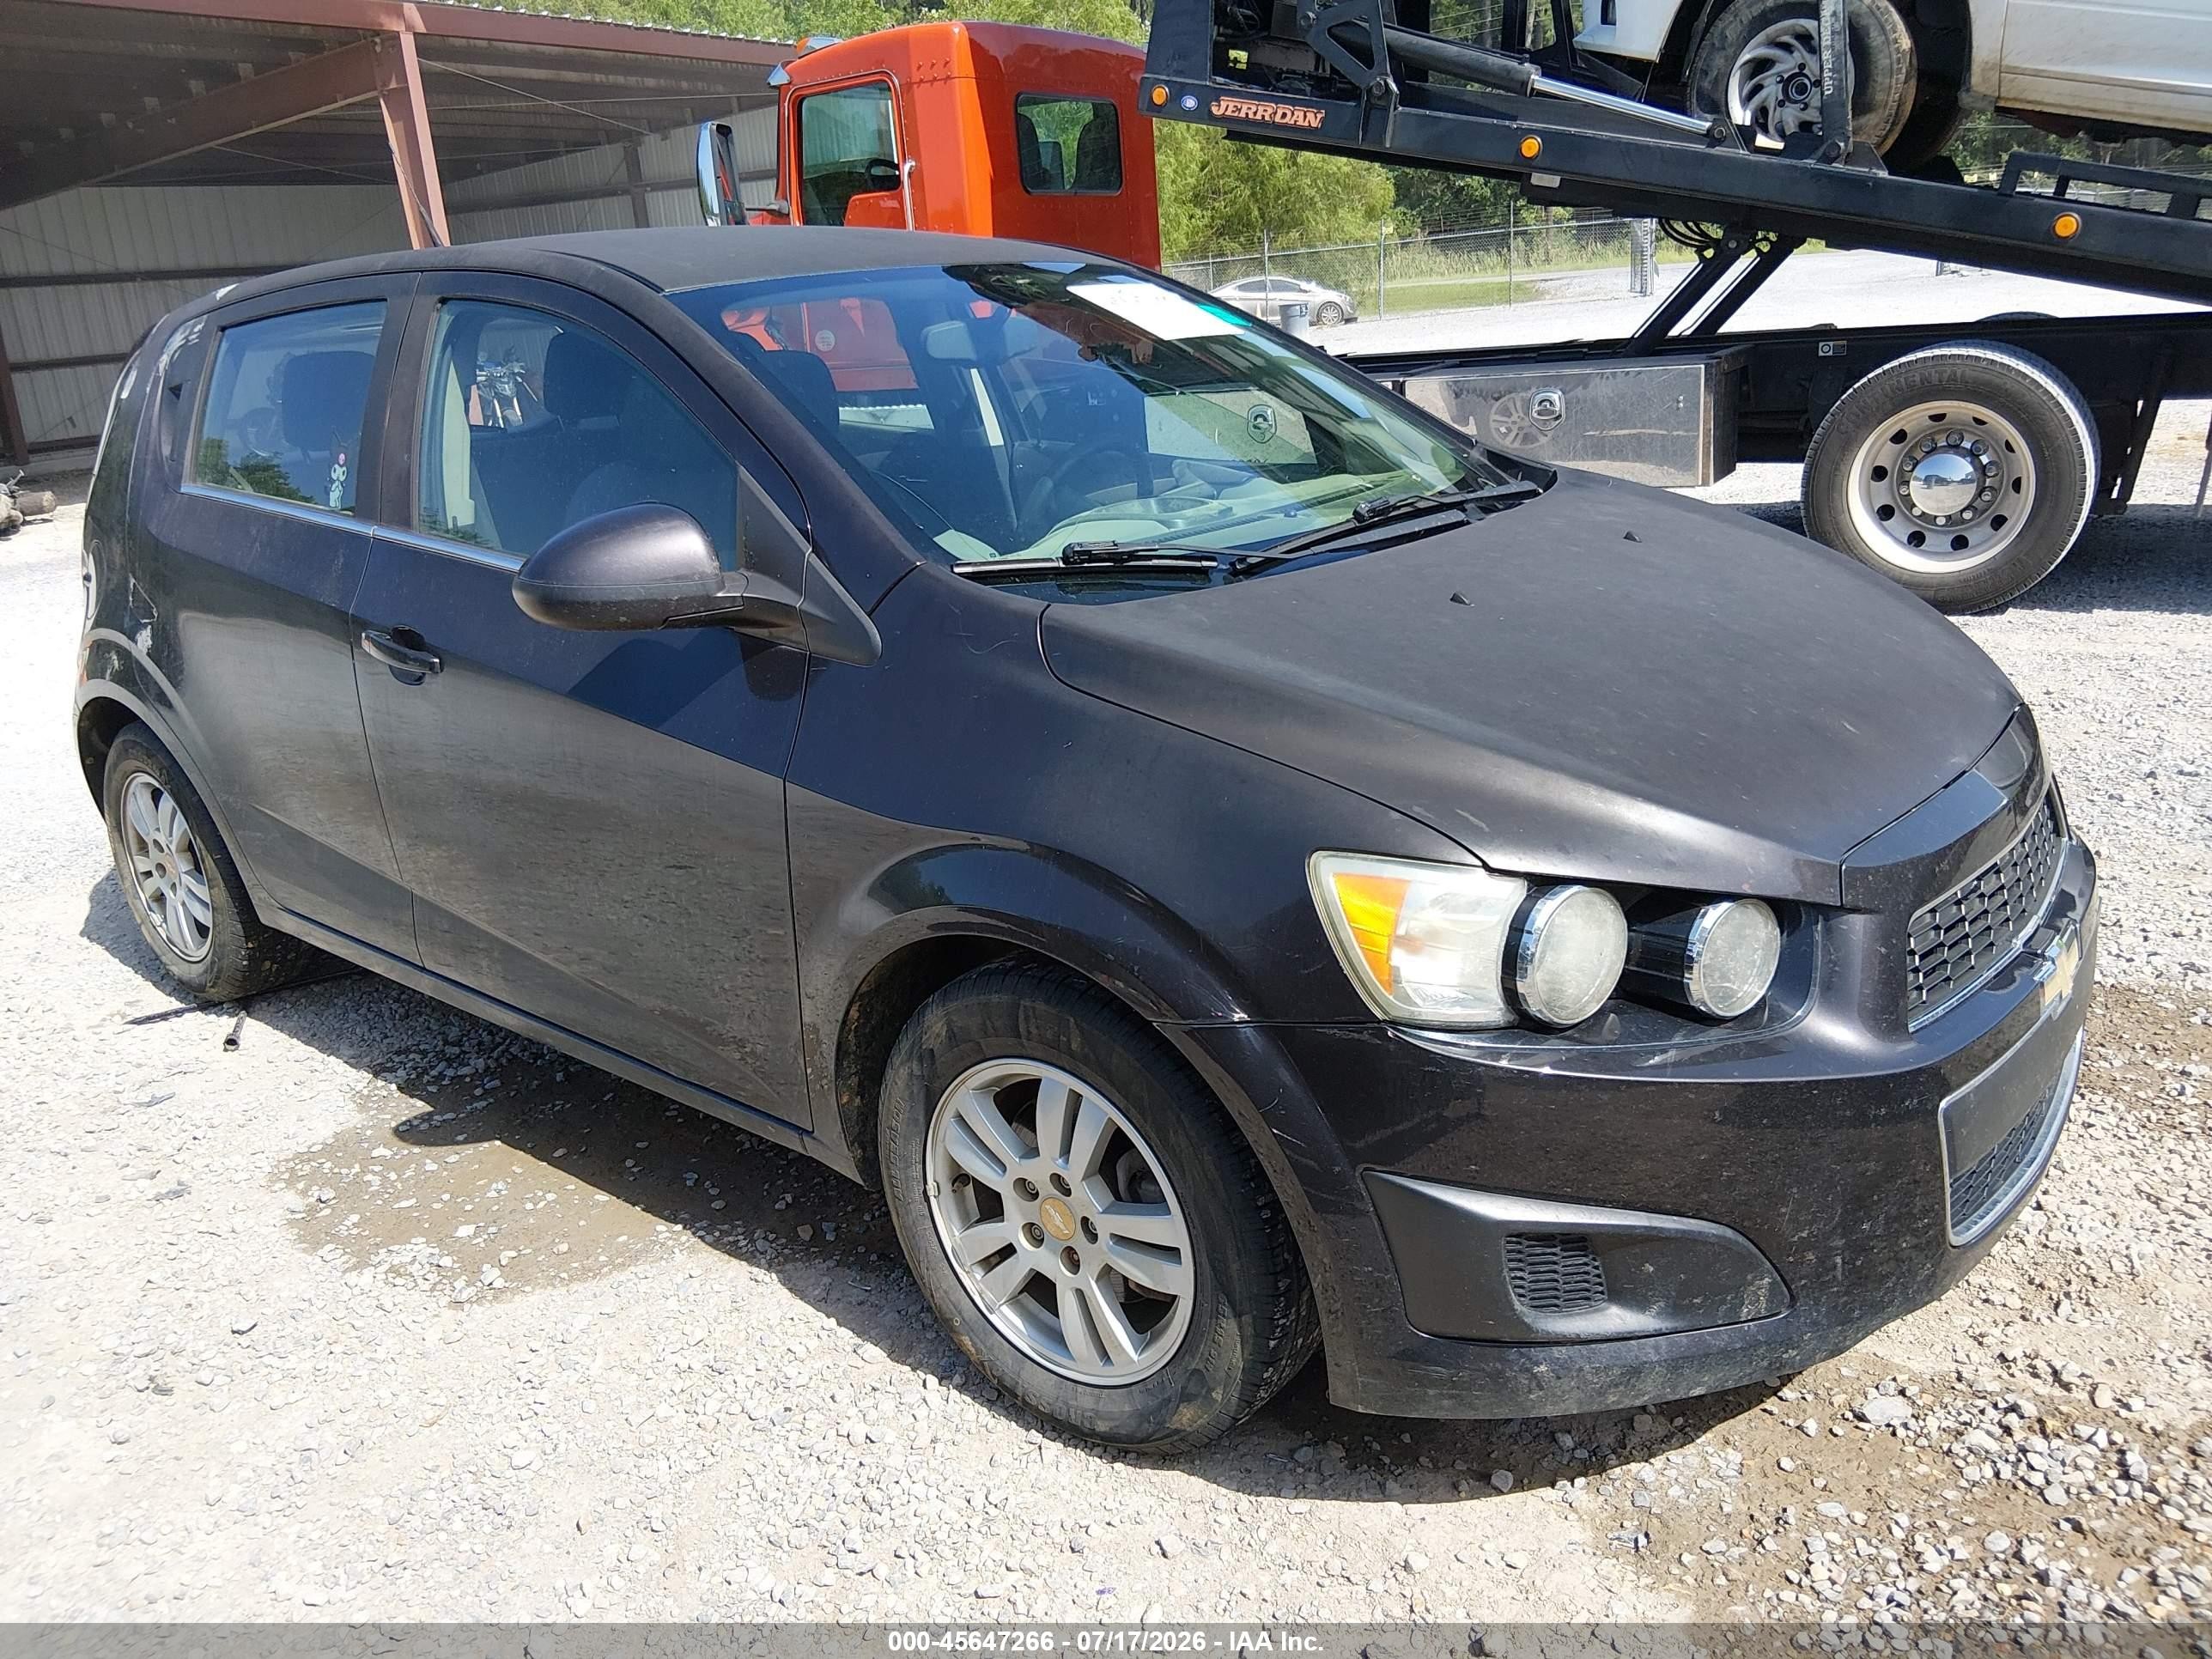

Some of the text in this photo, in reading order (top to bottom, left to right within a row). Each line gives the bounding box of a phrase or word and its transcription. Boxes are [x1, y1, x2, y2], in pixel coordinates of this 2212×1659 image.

[1821, 48, 1833, 96] UPPER
[890, 1097, 907, 1202] ALL SEASON
